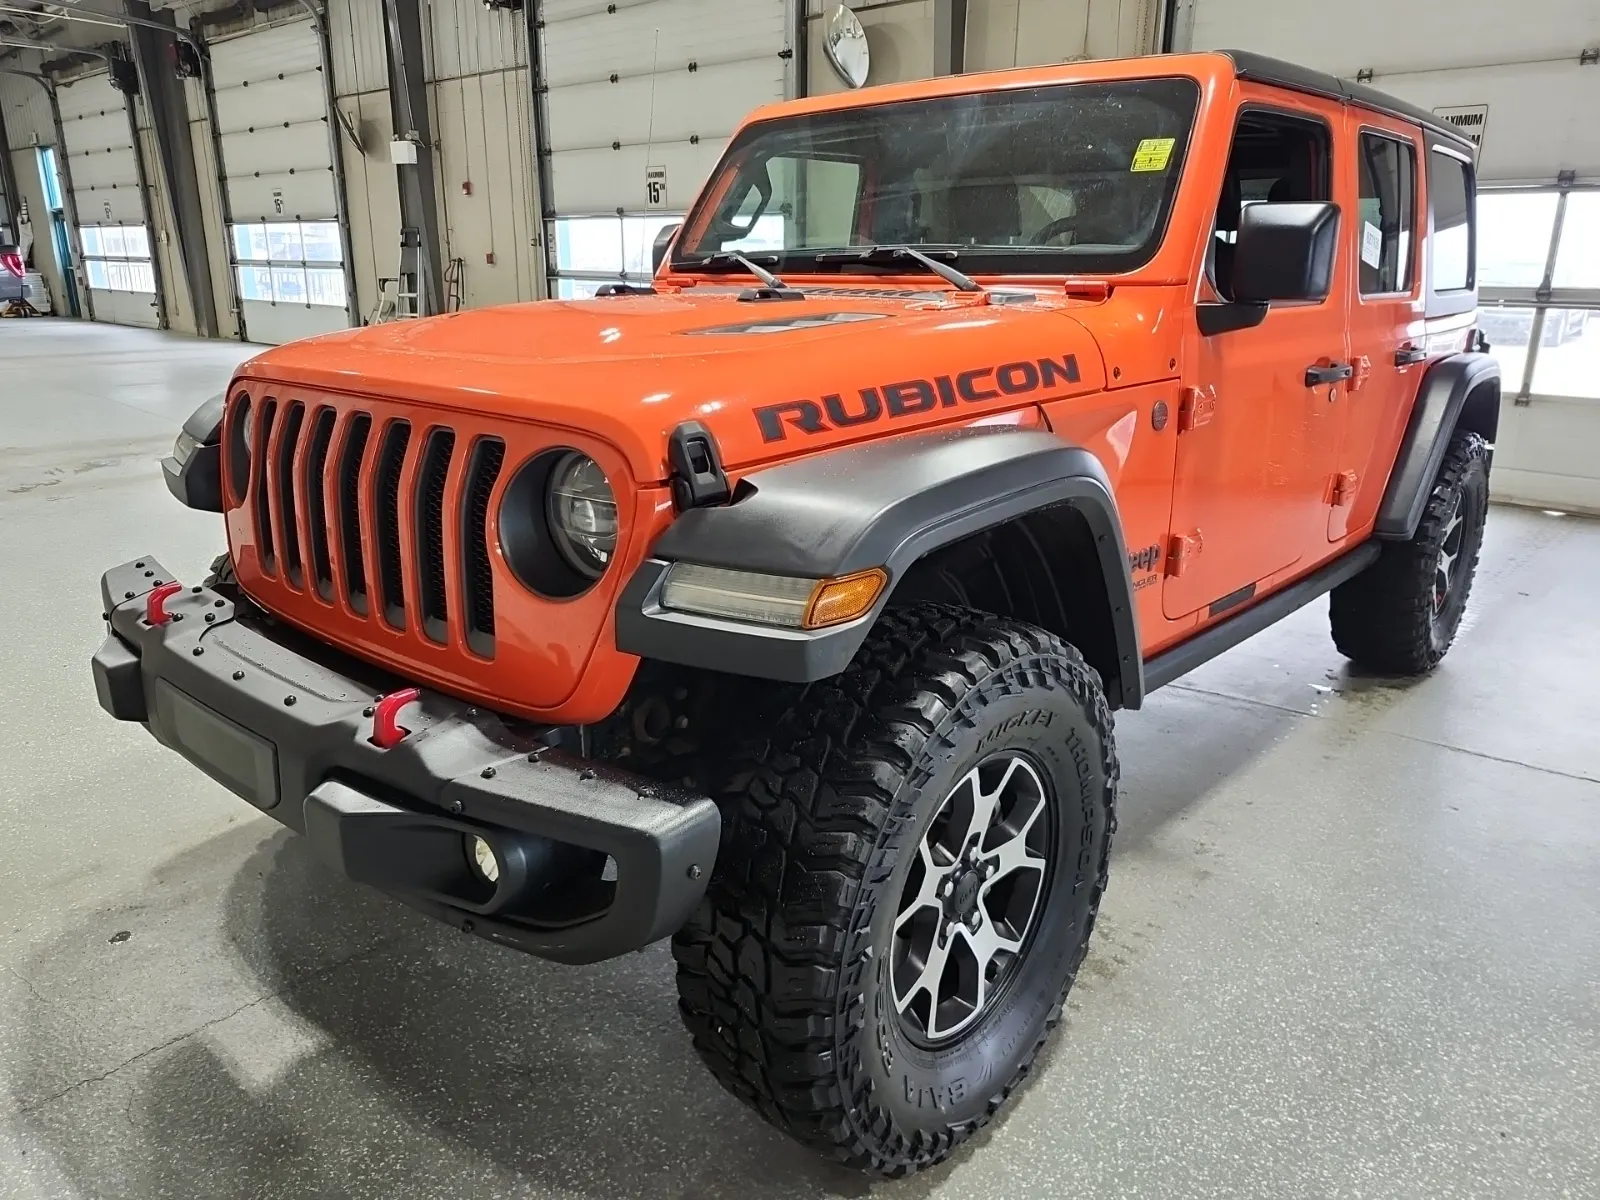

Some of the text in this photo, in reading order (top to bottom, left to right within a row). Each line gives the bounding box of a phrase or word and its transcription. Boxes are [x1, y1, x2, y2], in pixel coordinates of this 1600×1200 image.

[1441, 113, 1483, 126] XIMUM
[647, 181, 659, 204] 15
[752, 353, 1082, 444] RUBICON
[1129, 544, 1161, 573] eep
